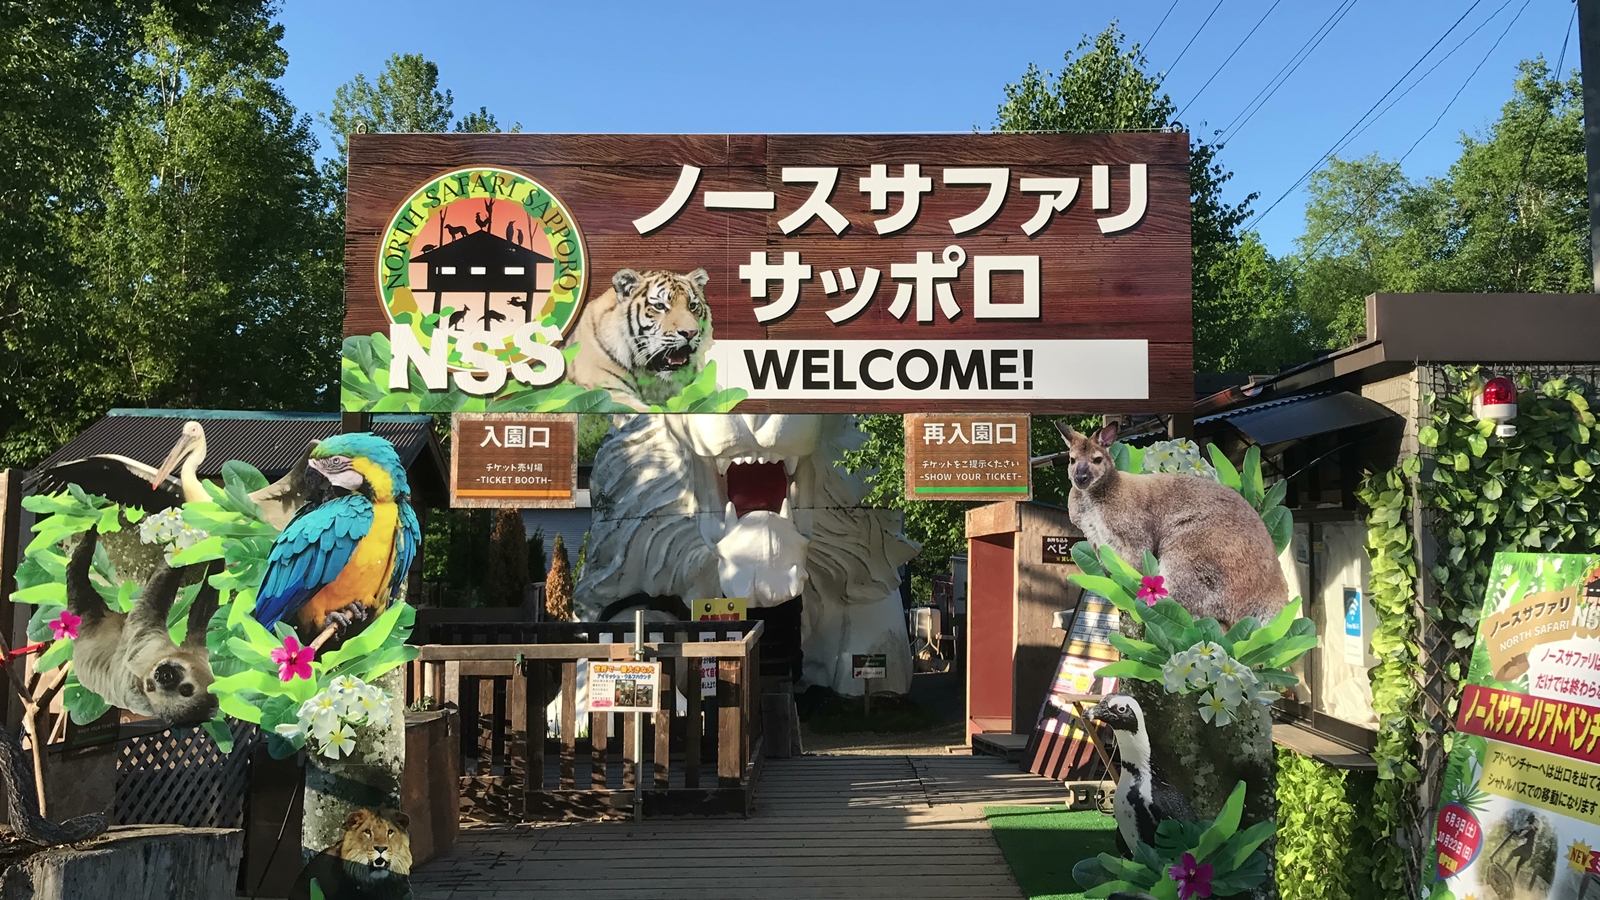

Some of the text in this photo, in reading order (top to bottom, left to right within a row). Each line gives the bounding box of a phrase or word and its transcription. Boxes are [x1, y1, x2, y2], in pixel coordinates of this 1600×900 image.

[632, 163, 1149, 237] ノースサファリ
[384, 174, 579, 292] NORTH SAFARI SAPPORO
[738, 244, 1042, 324] サッポロ
[388, 320, 566, 396] NSS
[743, 348, 1034, 391] WELCOME!
[480, 425, 550, 448] 入園口
[922, 421, 1017, 445] 再入園口
[485, 462, 543, 472] チケット売り場
[1489, 596, 1572, 640] ノースサファリ
[1499, 619, 1570, 652] NORTH SAFARI
[1570, 847, 1590, 867] NEW
